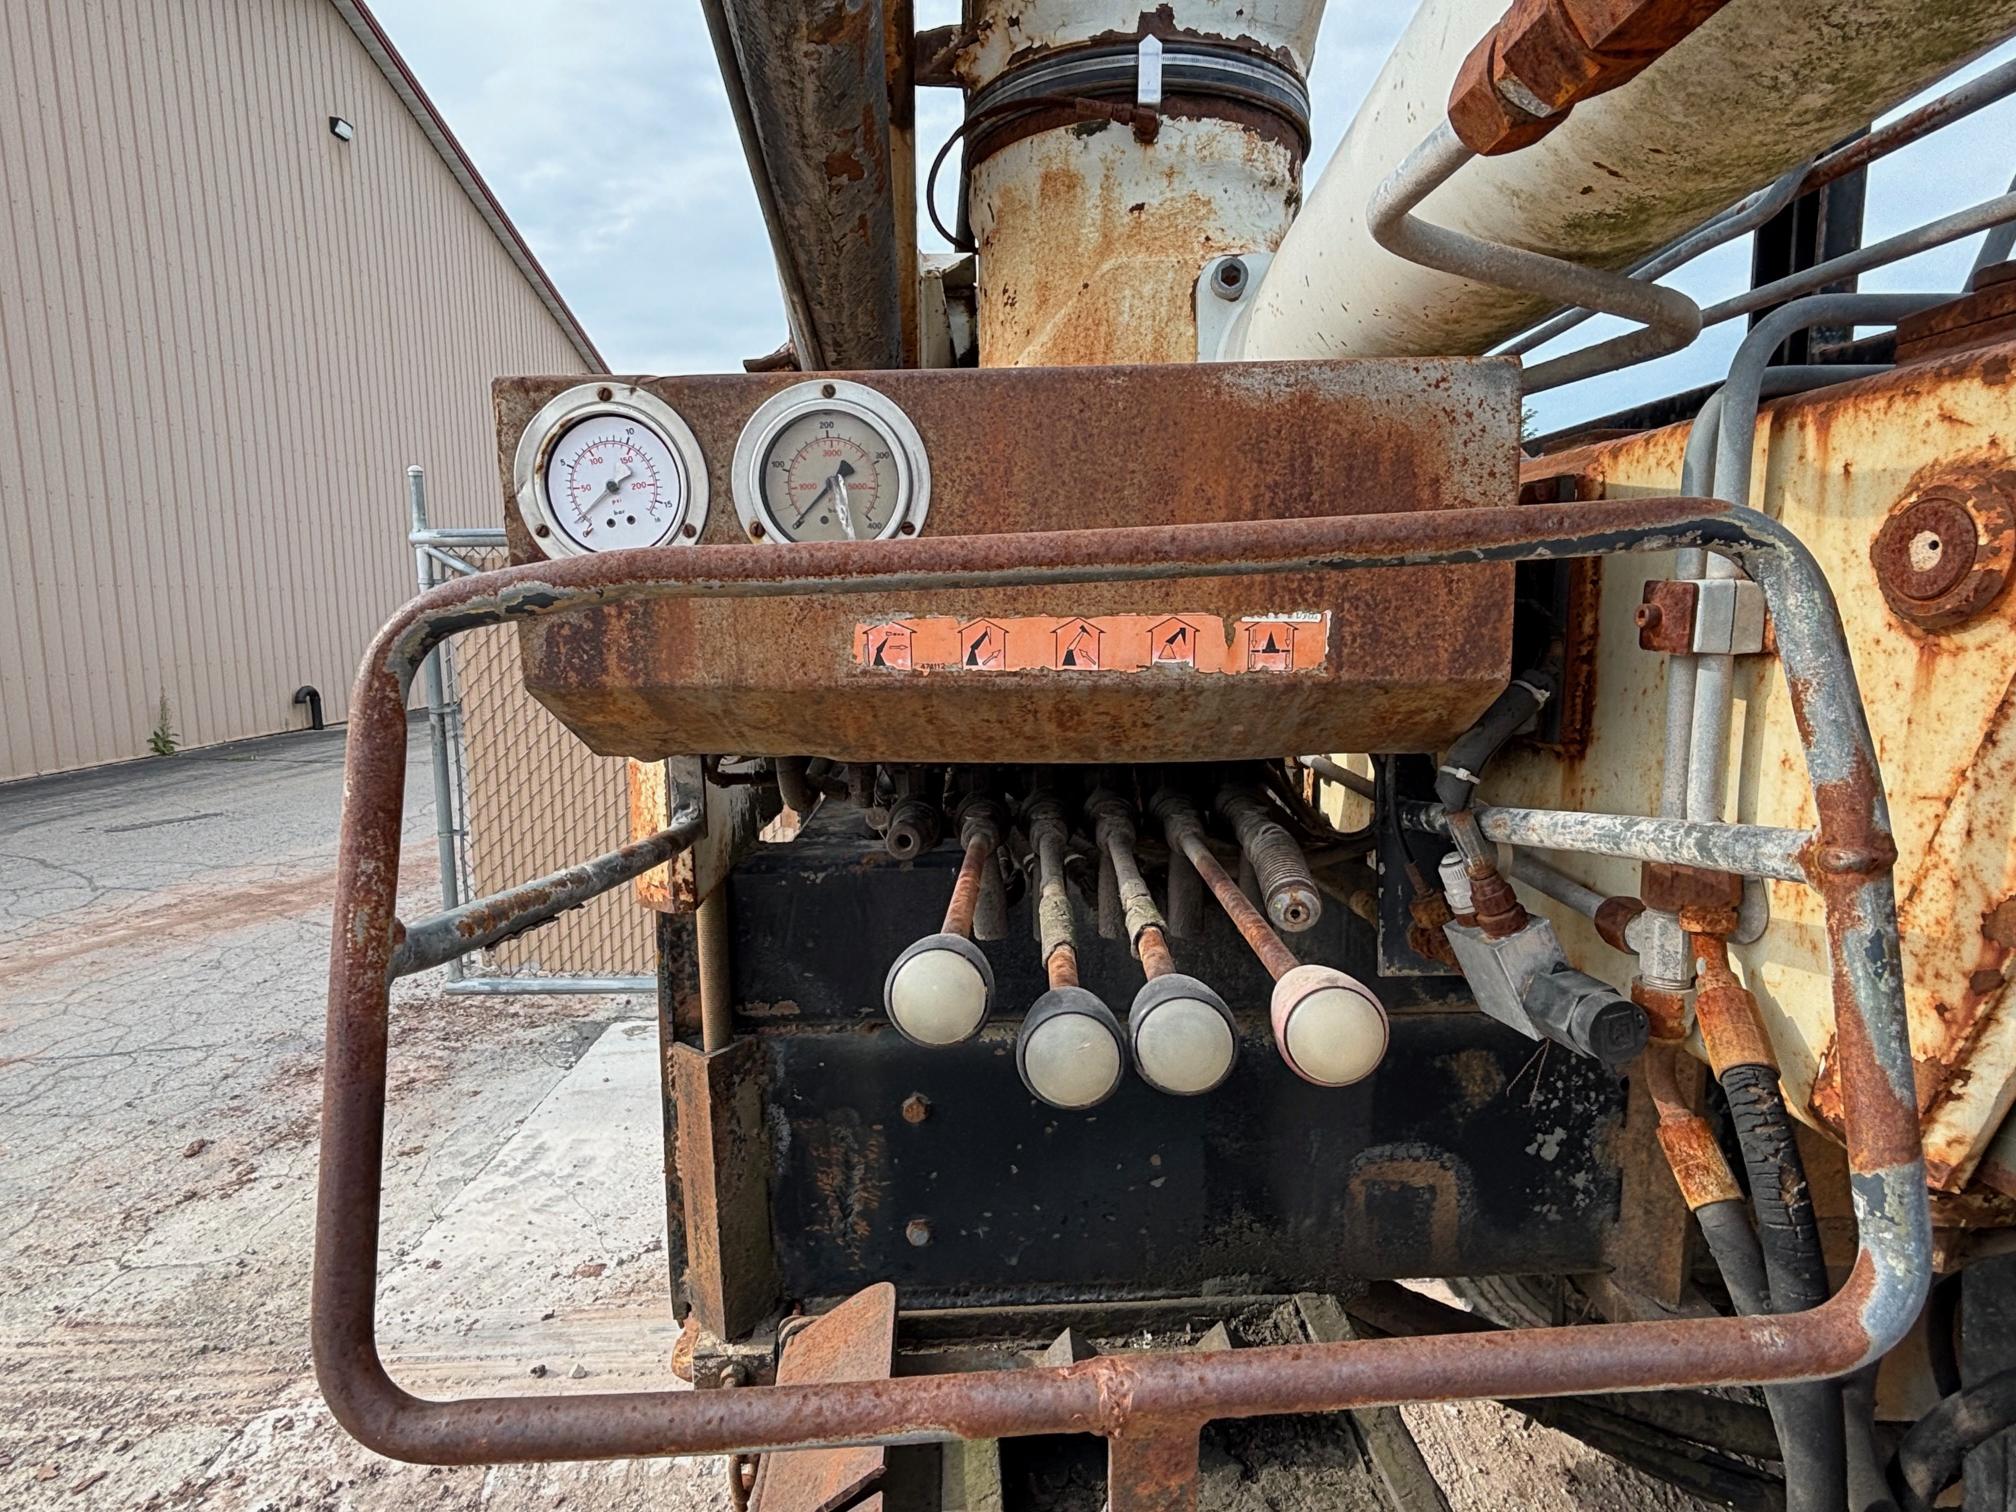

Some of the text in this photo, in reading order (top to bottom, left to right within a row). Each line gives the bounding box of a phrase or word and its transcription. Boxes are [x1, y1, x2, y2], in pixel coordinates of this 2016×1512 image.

[819, 421, 834, 429] 200
[626, 427, 635, 436] 10
[590, 457, 604, 465] 100
[621, 456, 634, 465] 150
[771, 460, 785, 468] 100
[581, 483, 592, 492] 50
[631, 481, 647, 491] 200
[663, 500, 673, 508] 15
[867, 521, 882, 530] 400
